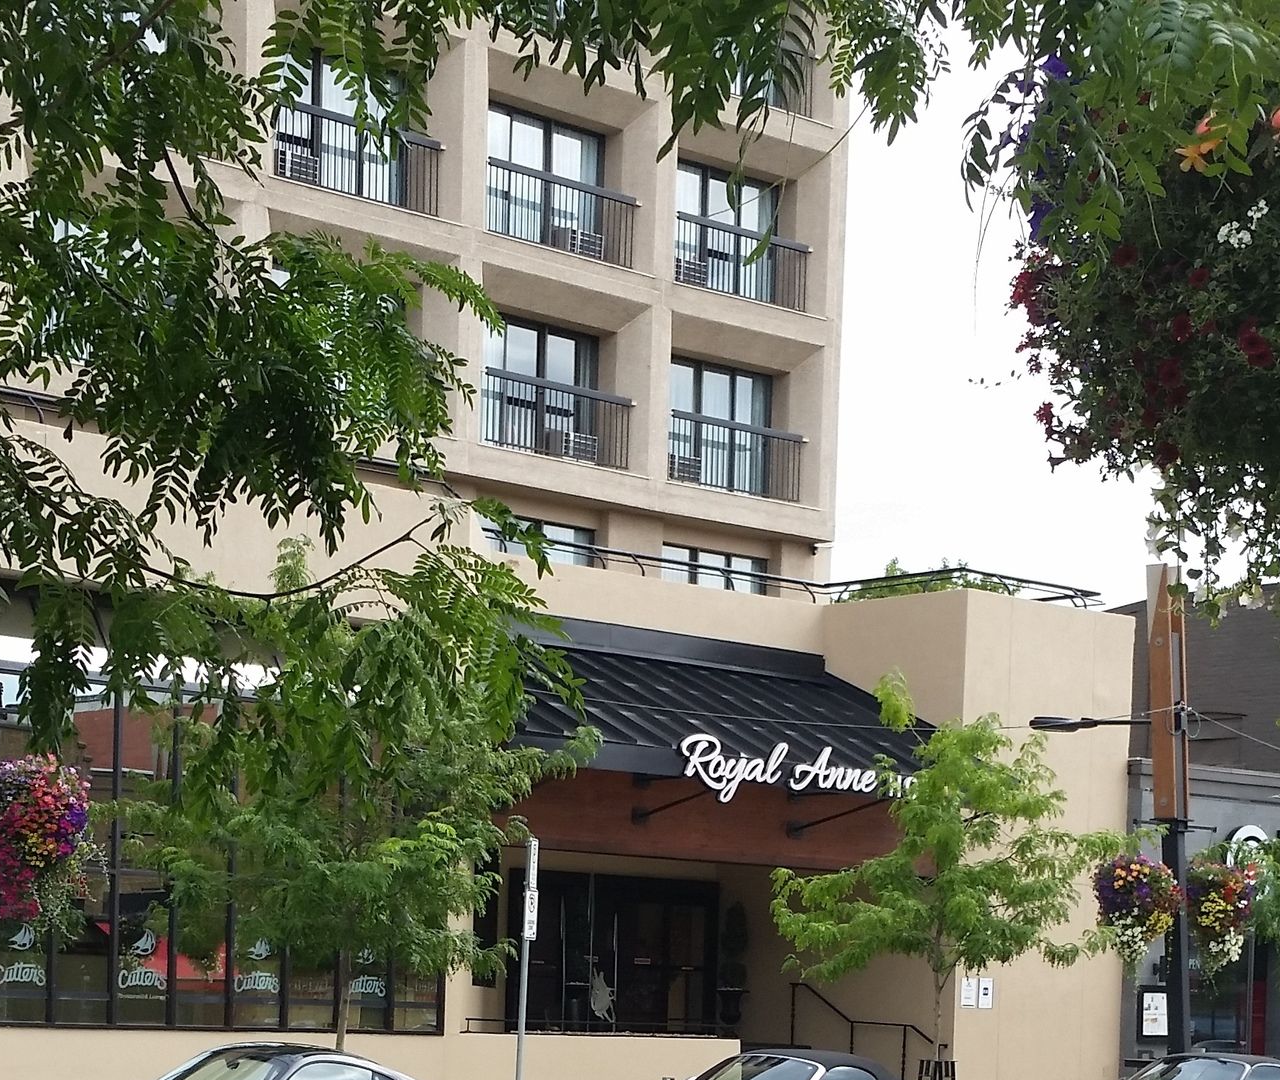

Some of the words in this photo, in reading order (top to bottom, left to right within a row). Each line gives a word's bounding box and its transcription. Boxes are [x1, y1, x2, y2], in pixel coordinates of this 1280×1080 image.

[681, 733, 789, 803] Royal
[790, 746, 878, 793] Anne
[1188, 959, 1201, 970] PEN
[118, 966, 168, 990] Cutter's
[234, 970, 280, 994] Cutter's
[350, 975, 387, 997] utter's
